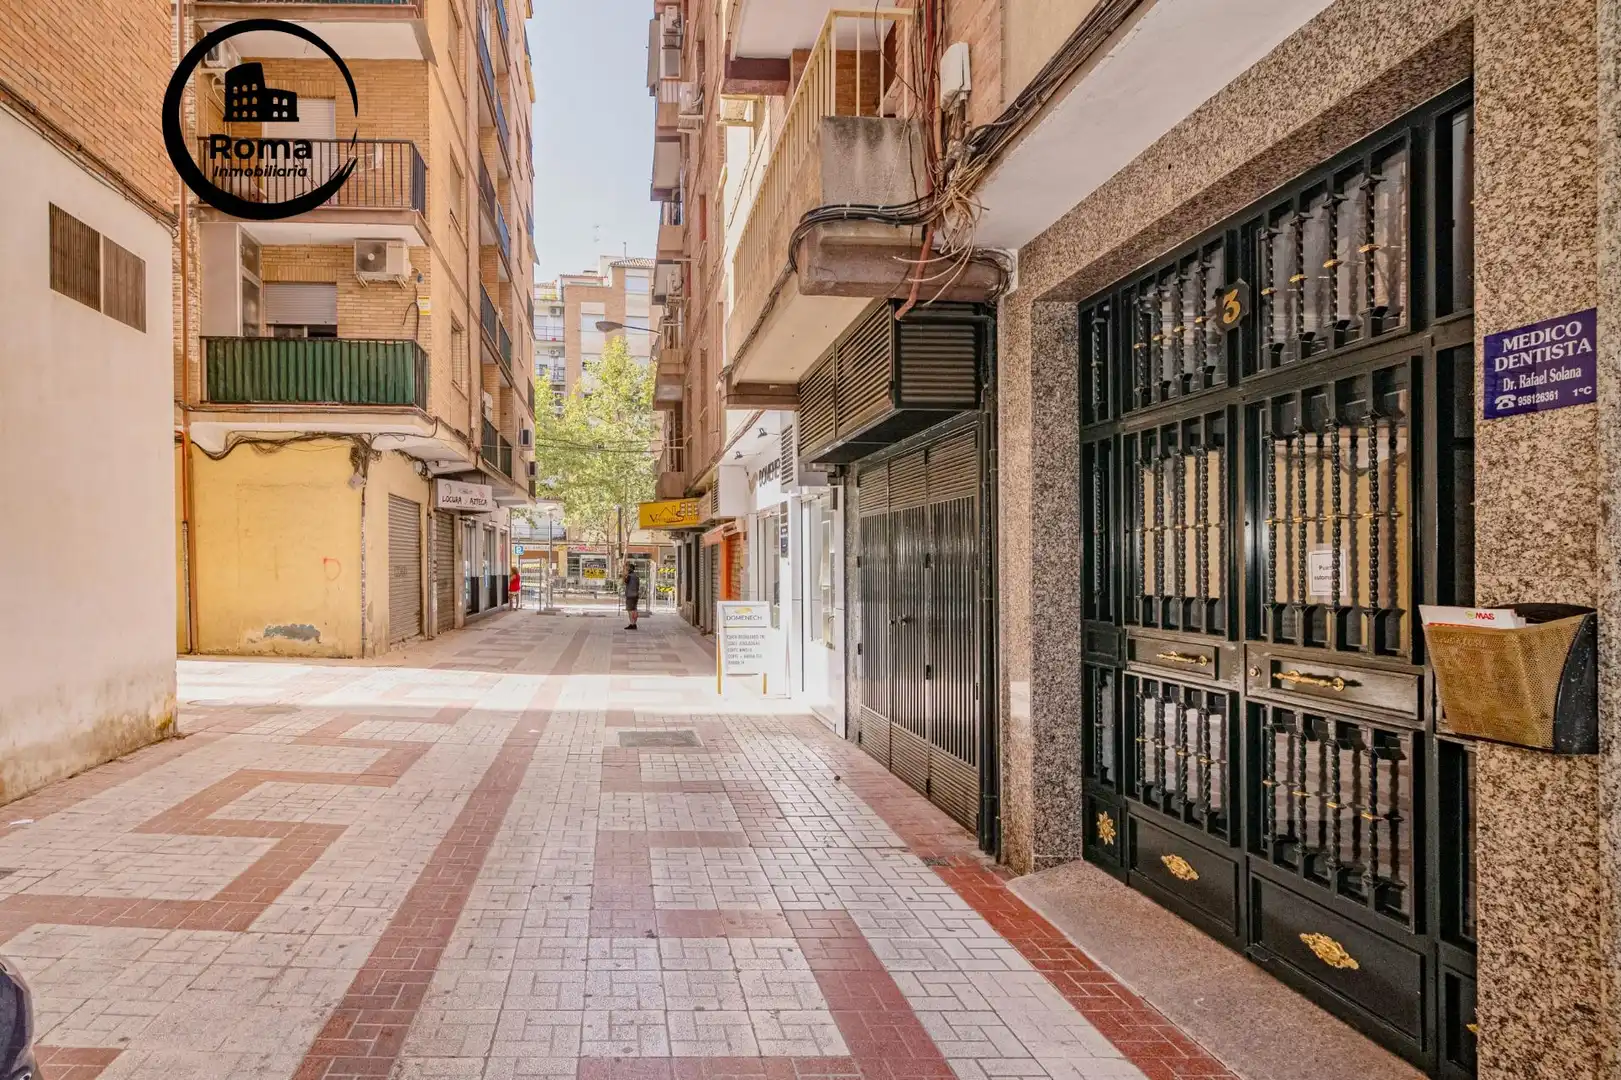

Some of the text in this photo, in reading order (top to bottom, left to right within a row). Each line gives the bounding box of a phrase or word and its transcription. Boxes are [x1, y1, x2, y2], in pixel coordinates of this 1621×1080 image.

[1222, 288, 1241, 324] 3
[1502, 320, 1583, 353] MEDICO
[1494, 337, 1593, 372] DENTISTA
[1502, 366, 1582, 392] Dr. Rafael Solana
[441, 495, 462, 504] LOCURA
[469, 497, 488, 506] AZTECA
